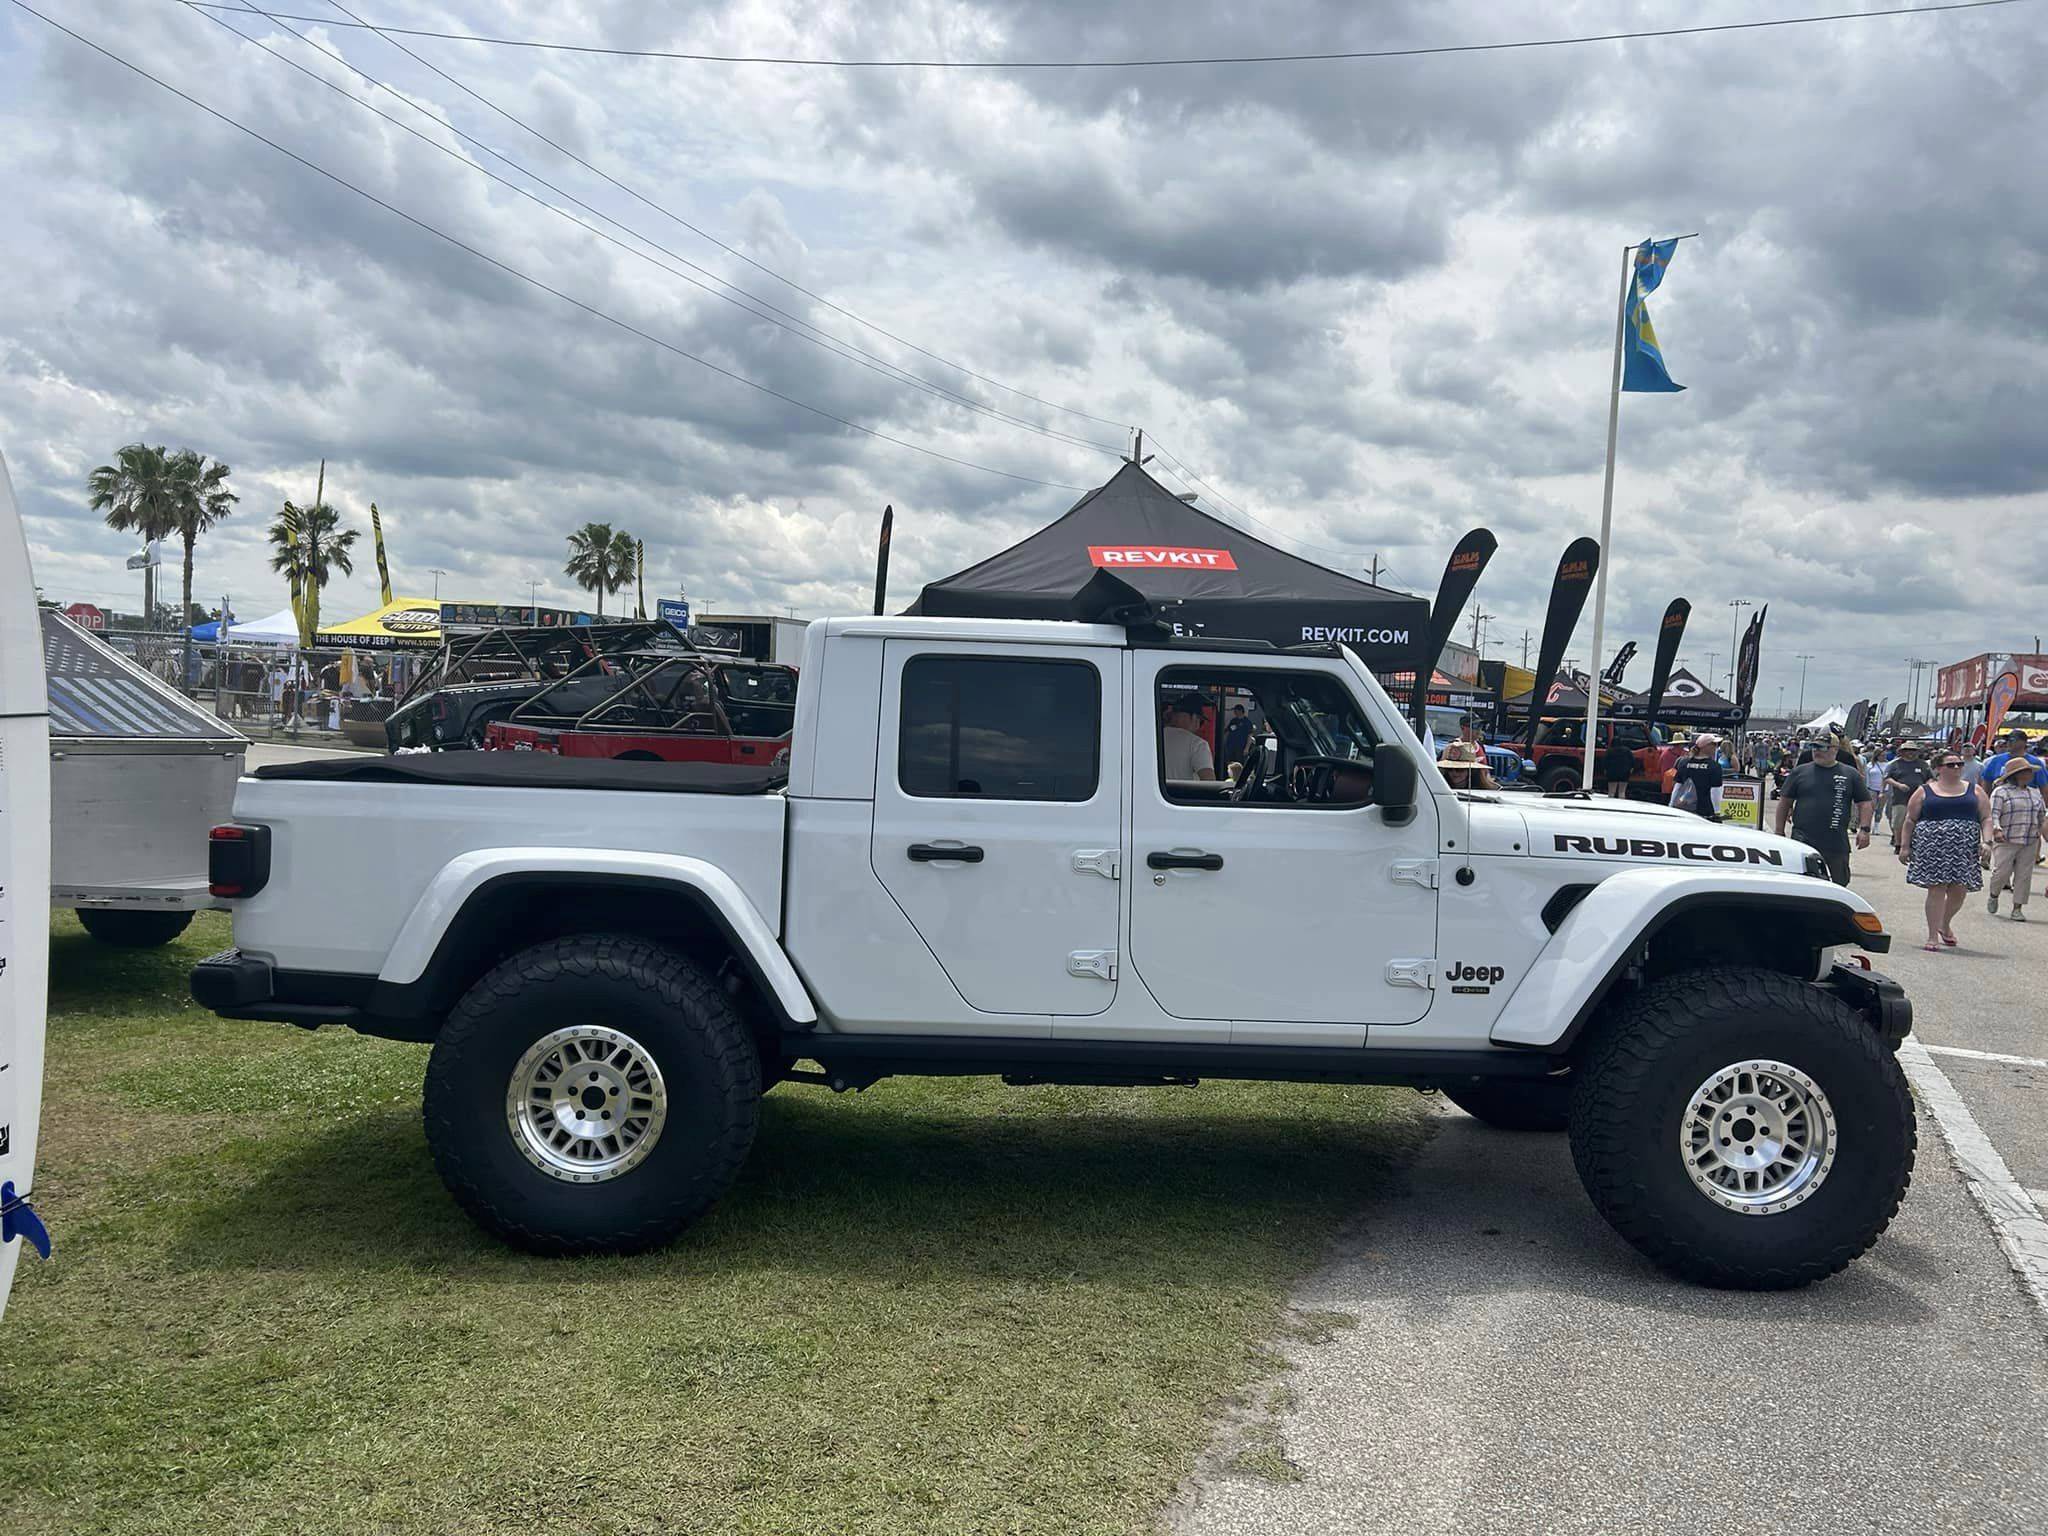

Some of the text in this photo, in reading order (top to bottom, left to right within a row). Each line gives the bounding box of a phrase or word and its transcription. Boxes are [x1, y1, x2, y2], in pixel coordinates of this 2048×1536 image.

[1102, 551, 1220, 565] REVKIT
[664, 607, 687, 617] GEICO
[315, 634, 329, 643] THE
[330, 635, 358, 644] HOUSE
[359, 636, 370, 645] OF
[1302, 626, 1409, 644] REVKIT.COM
[1727, 802, 1748, 810] WIN
[1724, 809, 1750, 818] $200
[1554, 834, 1783, 866] RUBICON
[1445, 961, 1504, 985] Jeep
